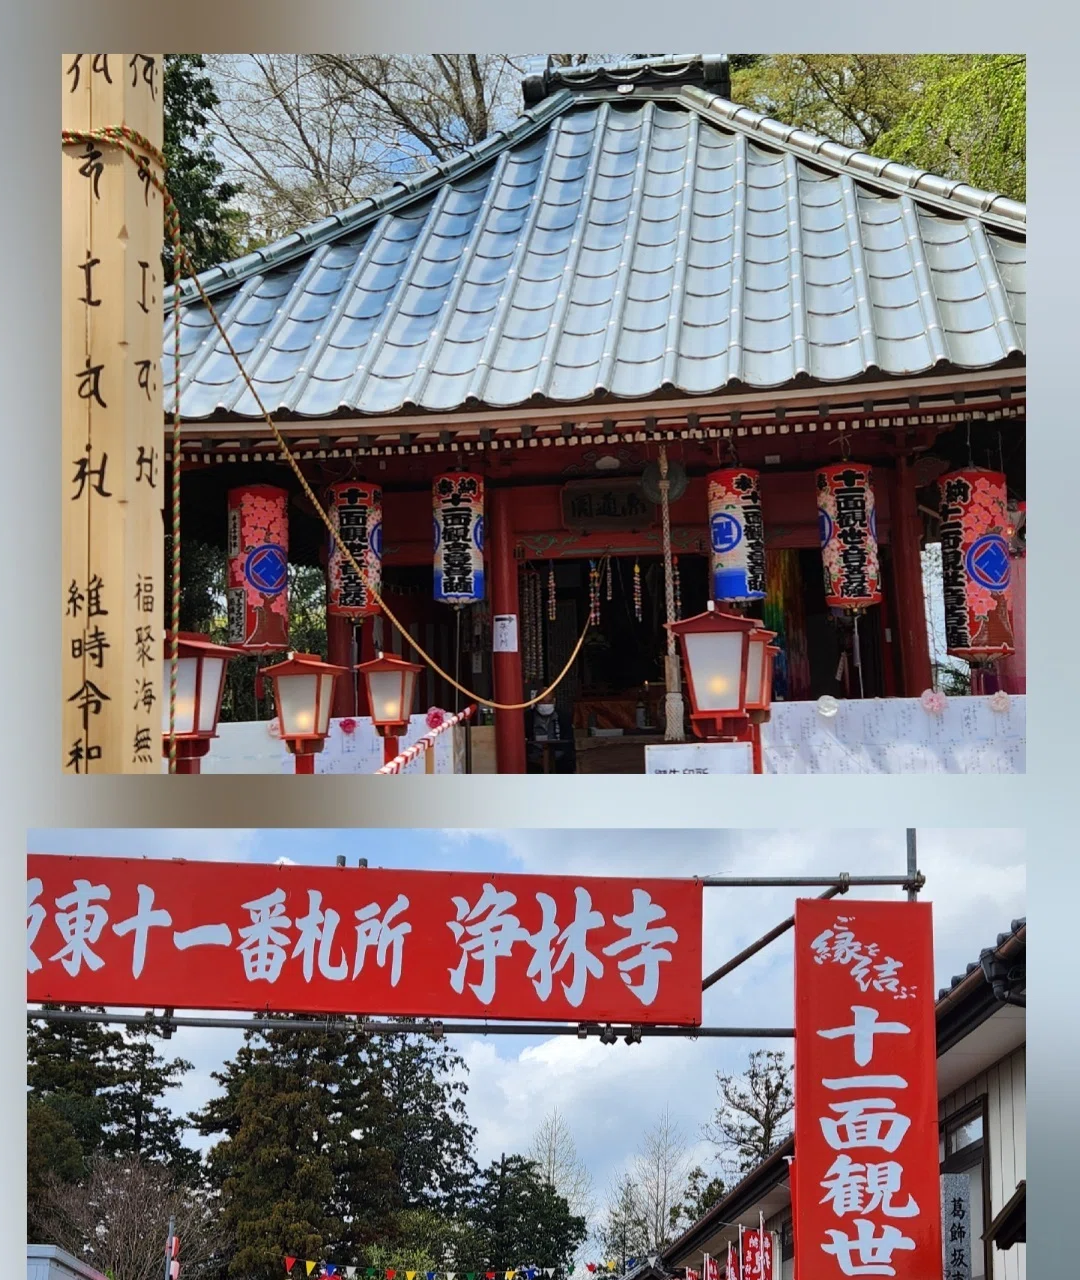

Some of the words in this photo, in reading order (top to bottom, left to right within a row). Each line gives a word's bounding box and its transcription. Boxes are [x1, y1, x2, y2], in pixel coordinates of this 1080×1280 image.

[65, 574, 112, 774] 維時令和
[132, 573, 157, 764] 福聚海無
[447, 883, 680, 1008] 浄林寺
